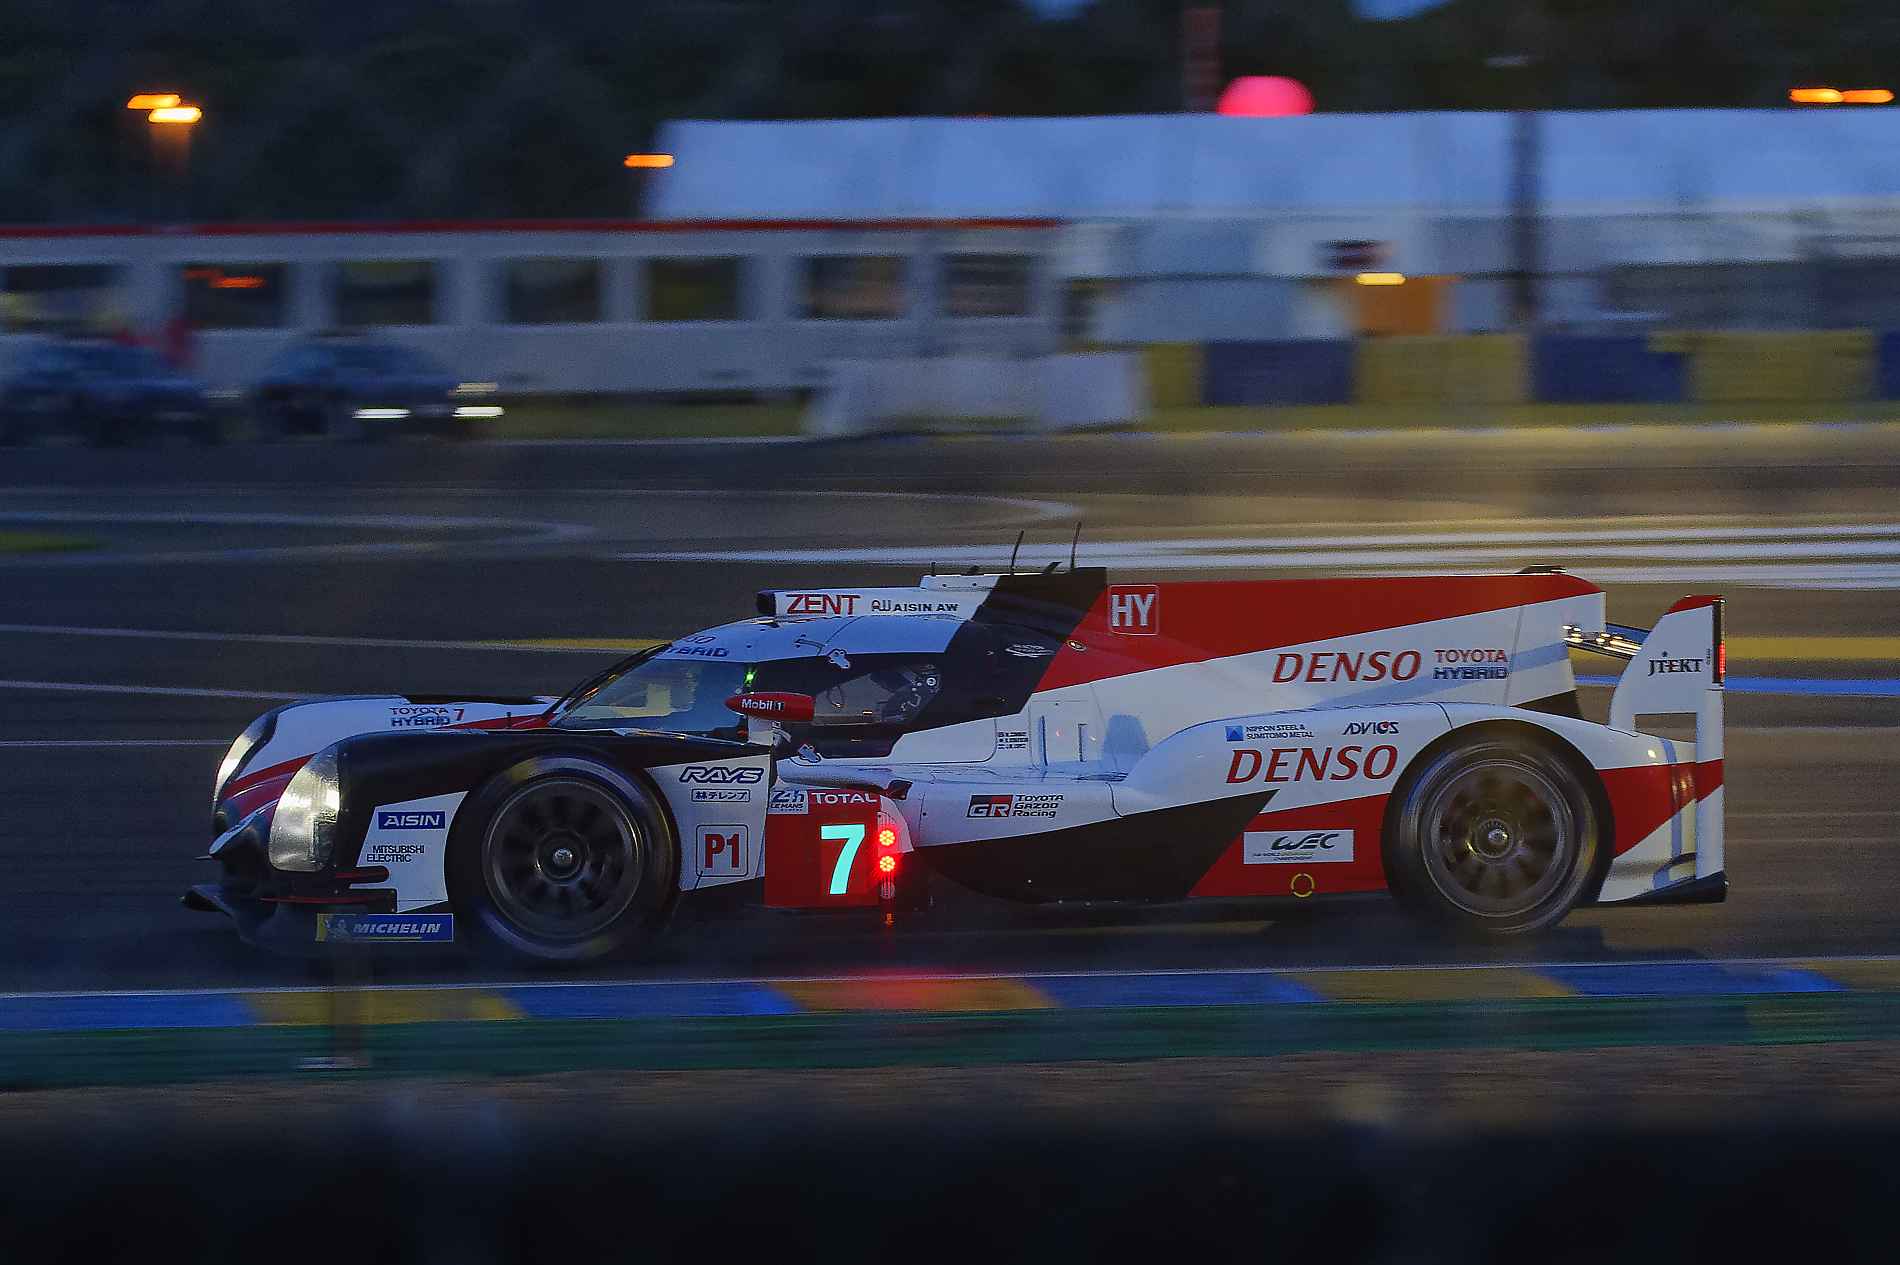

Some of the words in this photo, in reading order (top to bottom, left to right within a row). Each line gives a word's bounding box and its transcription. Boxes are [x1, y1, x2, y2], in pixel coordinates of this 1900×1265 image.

[786, 594, 861, 615] ZENT
[893, 603, 933, 612] AISIN
[936, 603, 959, 612] AW
[1111, 593, 1155, 627] HY
[1433, 649, 1508, 663] TOYOTA
[1271, 650, 1422, 683] DENSO
[1432, 666, 1508, 680] HYBRID
[1648, 659, 1704, 677] JTEKT
[389, 707, 449, 715] TOYOTA
[741, 699, 773, 711] Mobil
[453, 708, 464, 721] 7
[391, 717, 450, 727] HYBRID
[1226, 744, 1399, 784] DENSO
[679, 766, 765, 784] RAYS
[811, 792, 878, 805] TOTAL
[969, 803, 1010, 817] GR
[1012, 809, 1057, 819] Racing
[383, 814, 440, 827] AISIN
[1270, 832, 1340, 851] WEC
[372, 845, 425, 854] MITSUBISHI
[704, 833, 740, 869] P1
[367, 854, 413, 863] ELECTRIC
[820, 824, 865, 895] 7
[353, 923, 441, 934] MICHELIN
